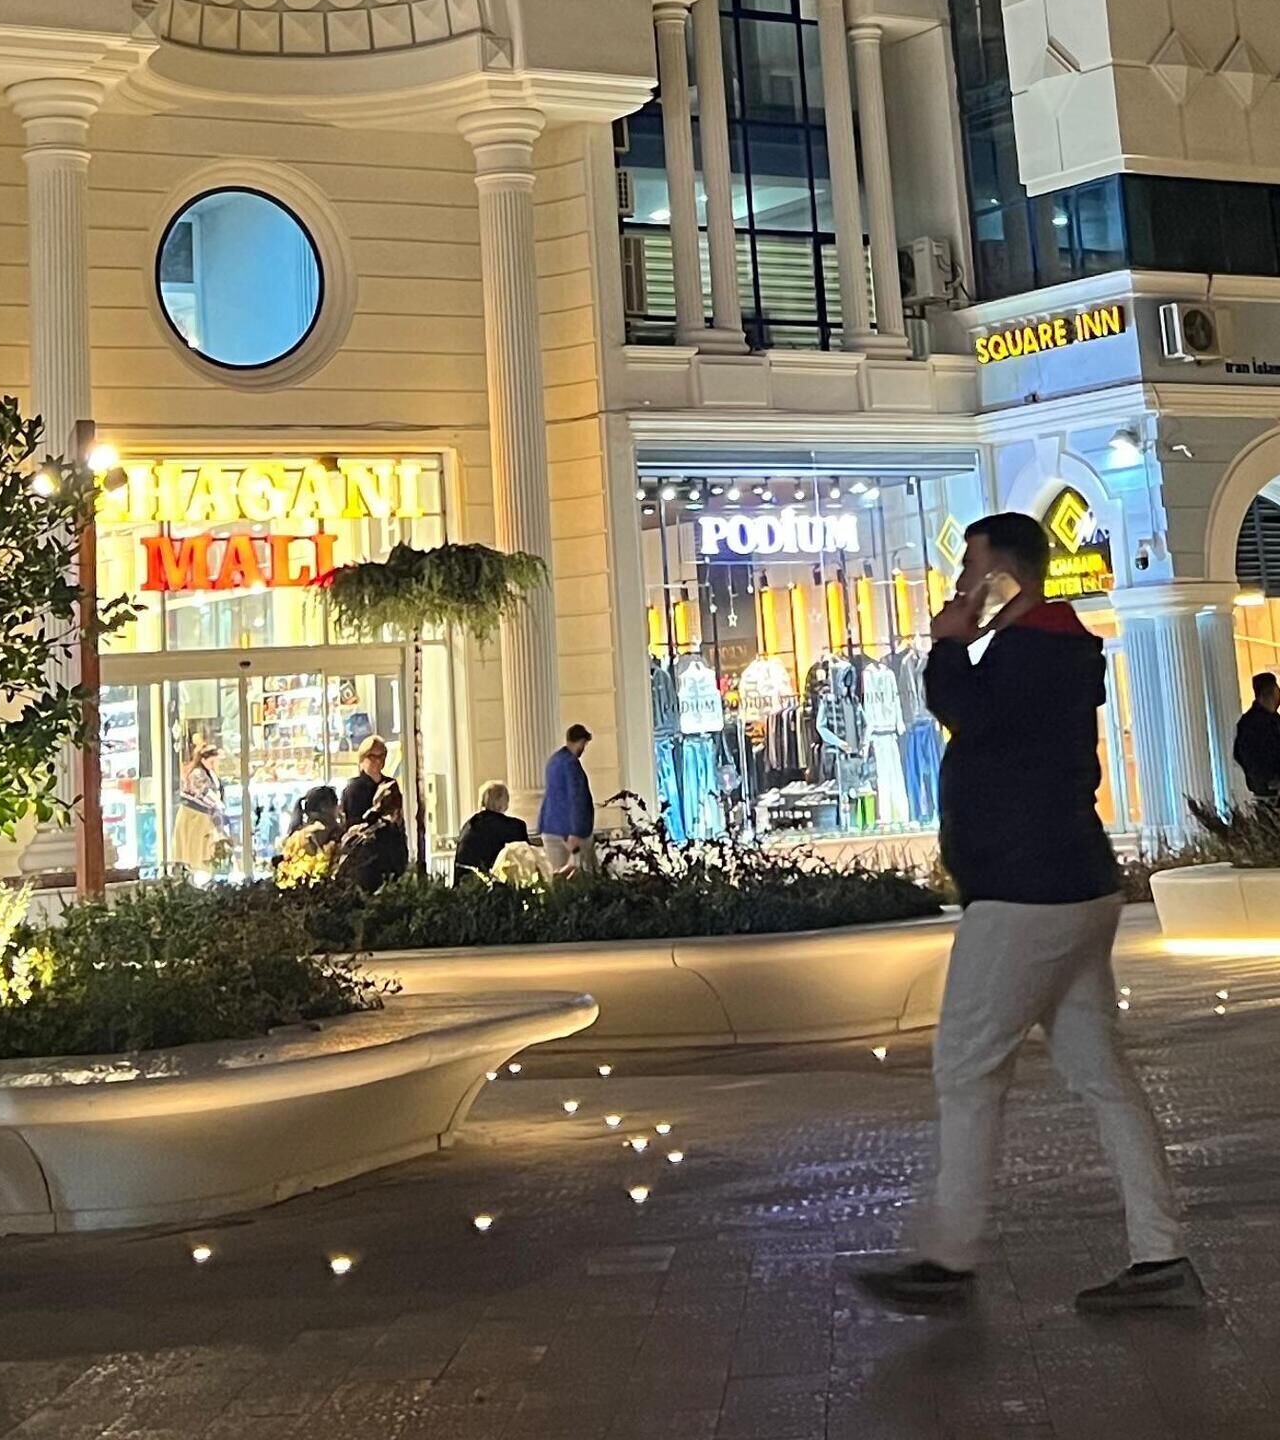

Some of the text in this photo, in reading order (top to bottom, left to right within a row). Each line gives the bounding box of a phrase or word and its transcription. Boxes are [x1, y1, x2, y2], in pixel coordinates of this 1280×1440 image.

[975, 306, 1123, 364] SQUARE INN
[96, 460, 424, 522] HAGANI
